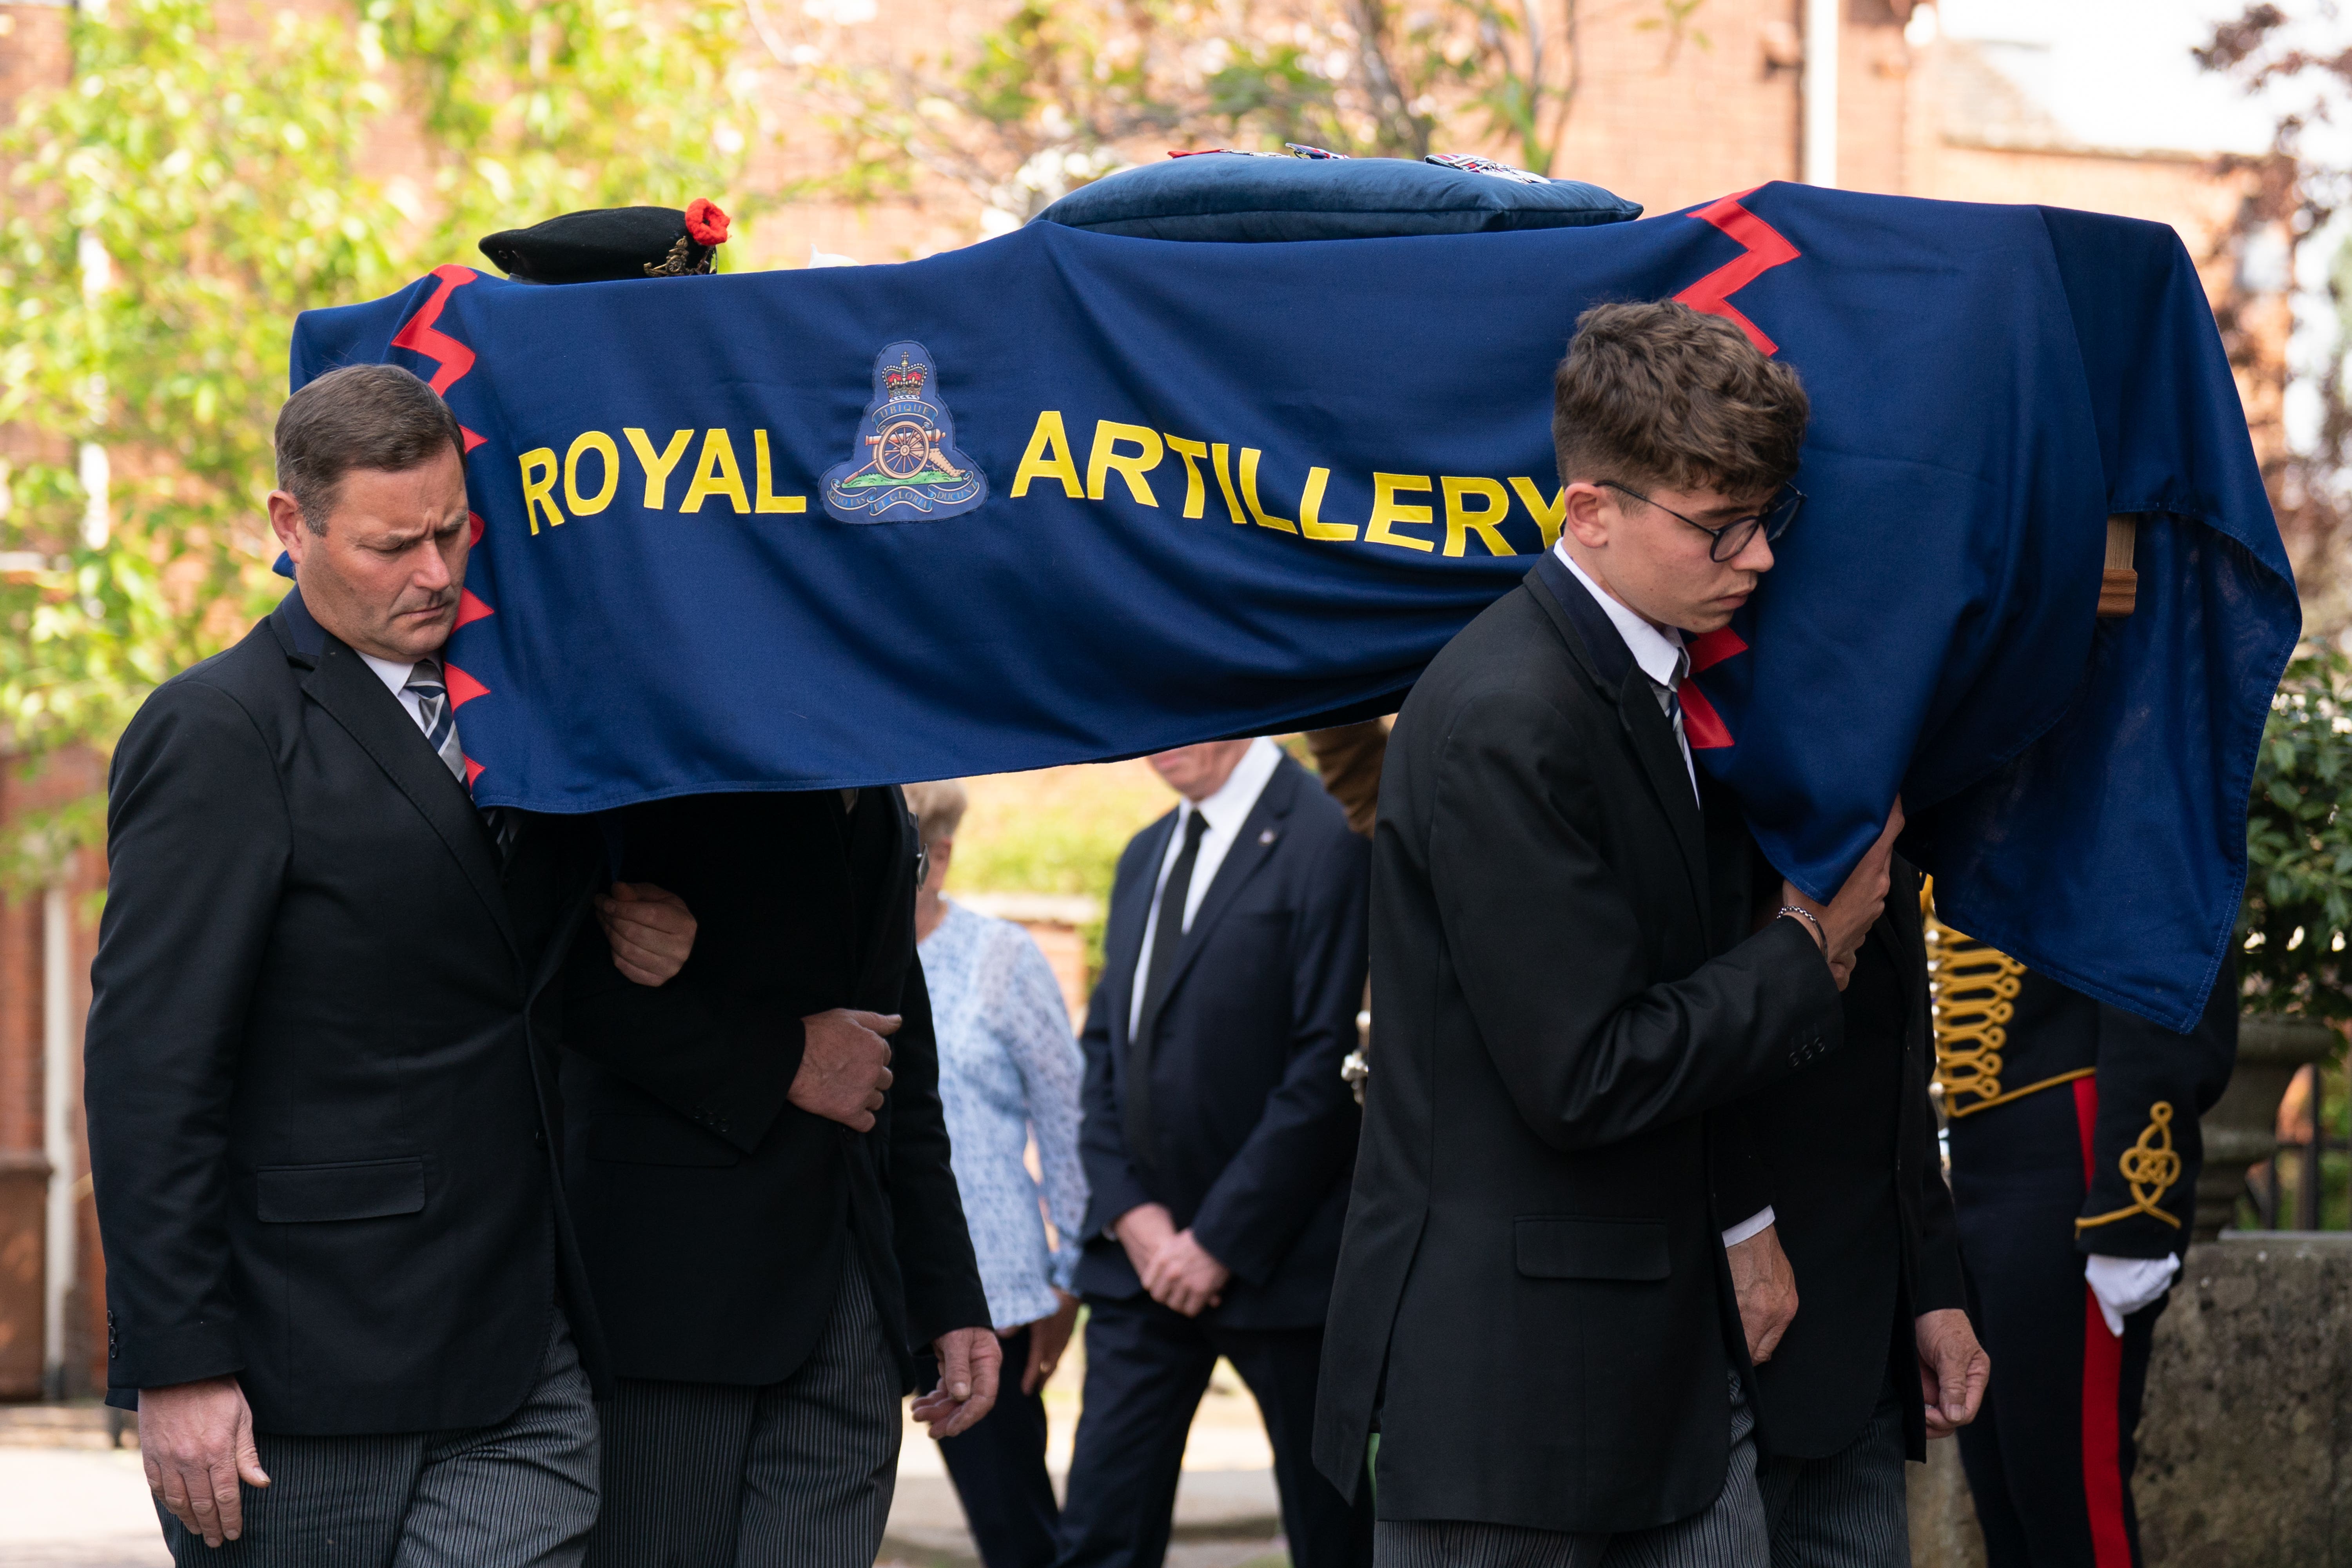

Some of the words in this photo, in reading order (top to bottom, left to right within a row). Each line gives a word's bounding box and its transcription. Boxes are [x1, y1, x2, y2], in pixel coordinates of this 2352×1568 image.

[880, 403, 929, 418] UBIQUE
[518, 428, 806, 535] ROYAL
[1010, 410, 1566, 557] ARTILLERY
[889, 491, 927, 508] GLORIA
